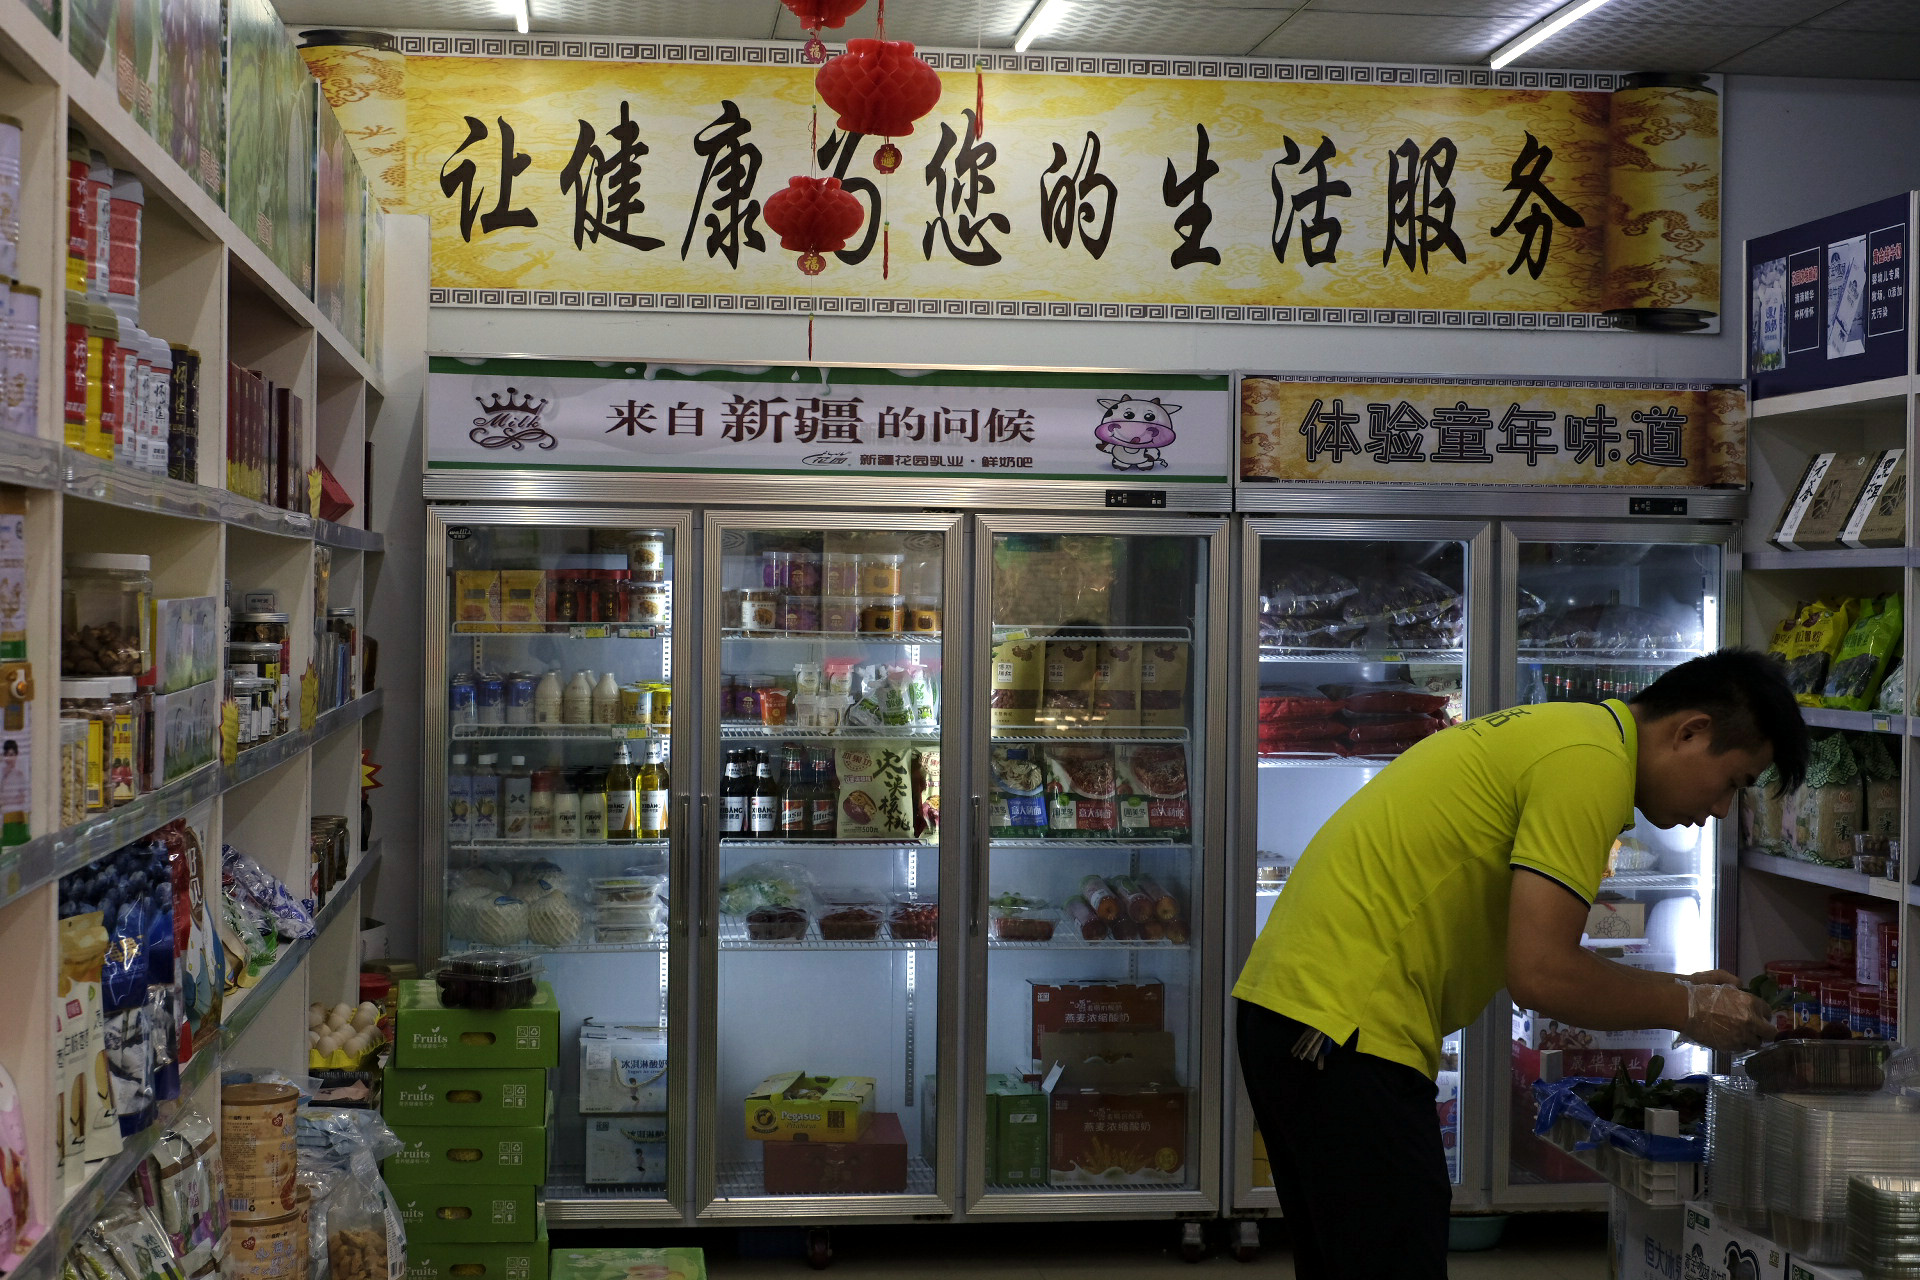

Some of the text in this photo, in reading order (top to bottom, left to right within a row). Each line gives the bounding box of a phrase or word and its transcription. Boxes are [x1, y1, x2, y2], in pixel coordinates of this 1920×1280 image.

[804, 256, 819, 271] 福
[473, 412, 542, 429] Milk
[605, 394, 1036, 445] 来自新疆的问候
[1299, 399, 1688, 468] 体验童年味道
[1078, 808, 1111, 818] 意大利面
[1065, 1013, 1130, 1024] 燕麦浓缩酸奶
[413, 1034, 448, 1043] Fruits
[400, 1091, 434, 1100] Fruits
[781, 1111, 822, 1122] Pegasus
[1084, 1122, 1151, 1132] 燕麦浓缩酸奶
[396, 1150, 430, 1159] Fruits
